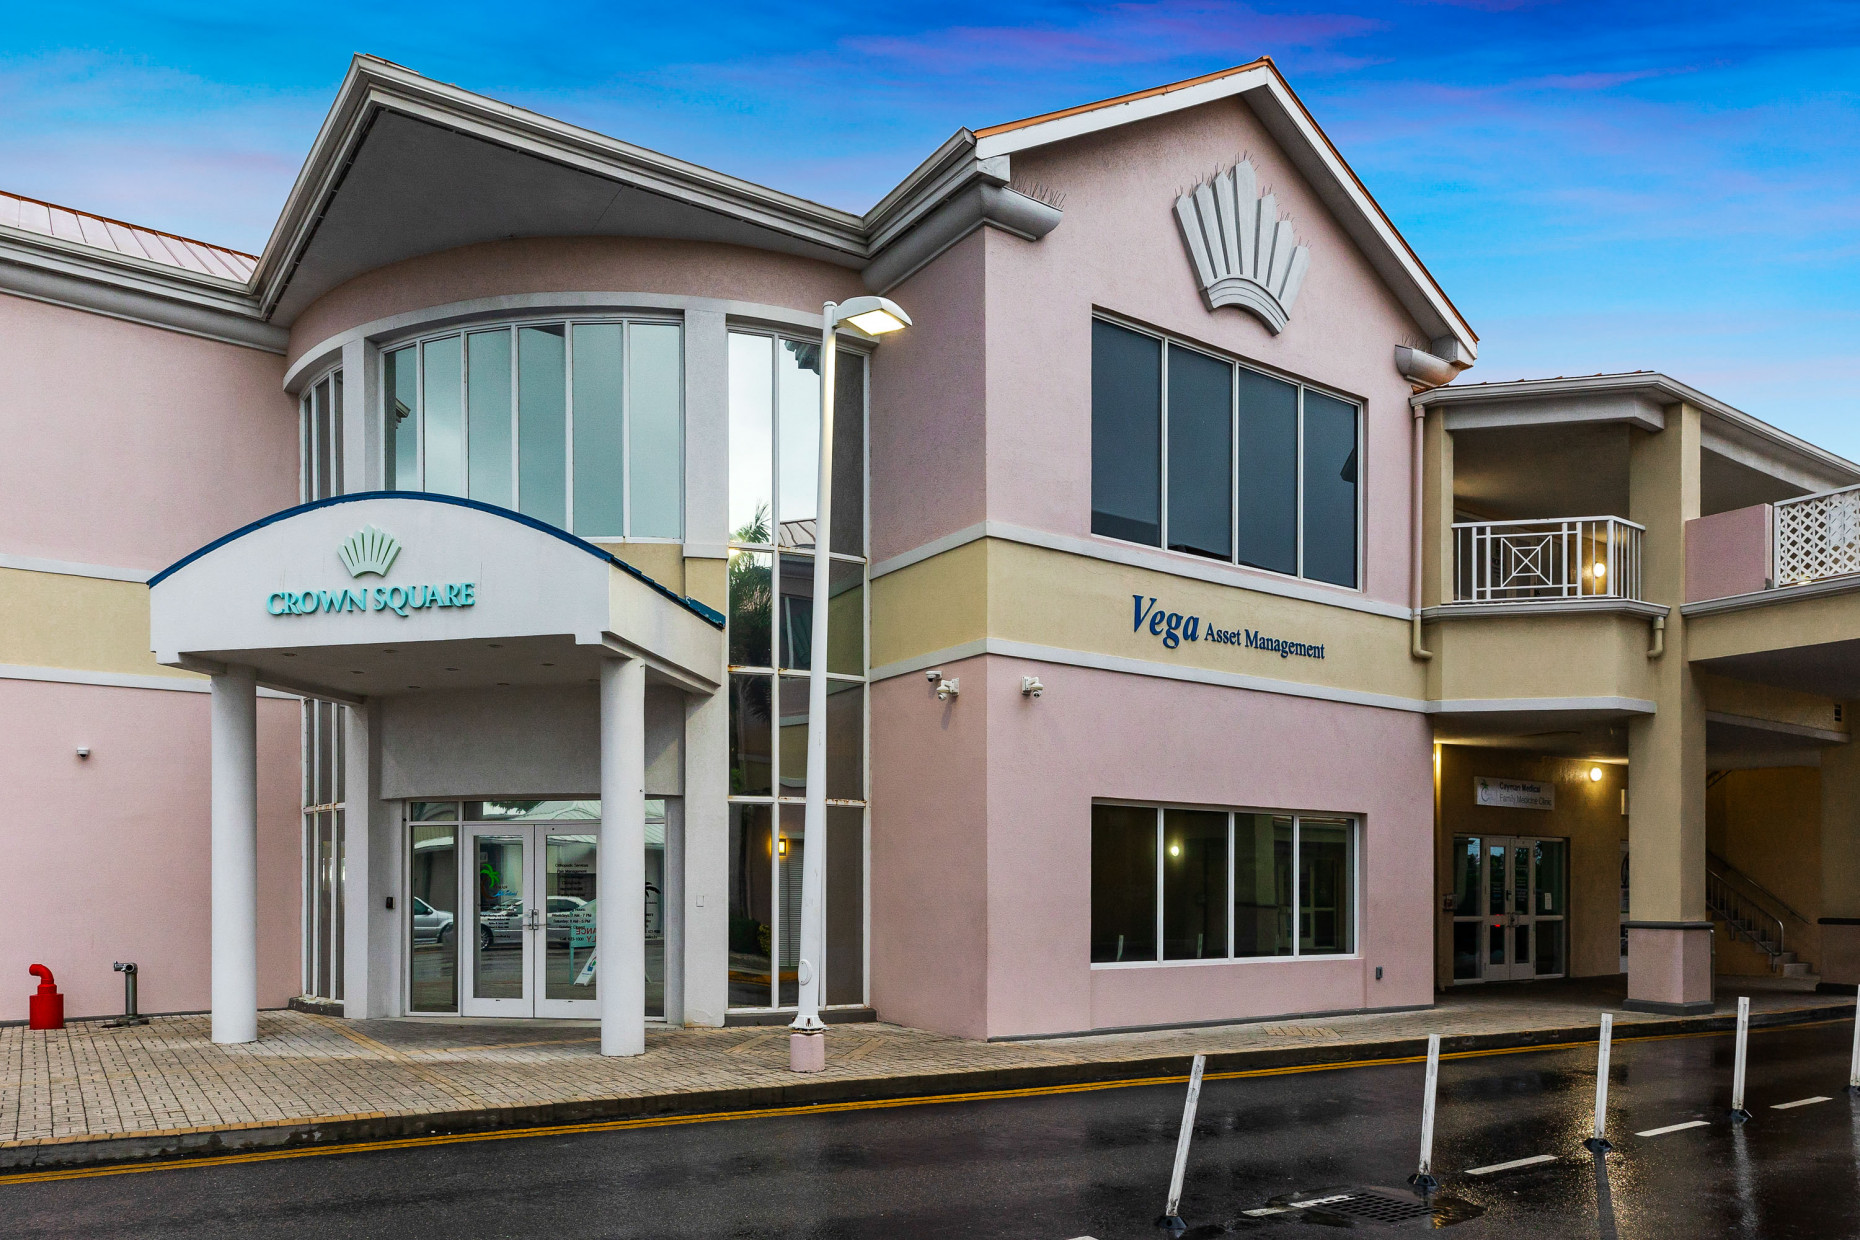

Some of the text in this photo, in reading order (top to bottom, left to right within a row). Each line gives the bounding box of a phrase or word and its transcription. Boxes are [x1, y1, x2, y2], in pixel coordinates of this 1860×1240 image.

[266, 582, 476, 617] CROWN SQUARE
[1132, 594, 1326, 659] Vega Asset Management
[1499, 782, 1541, 793] Cayman Medical
[1499, 794, 1552, 806] Family Medicine Clinic
